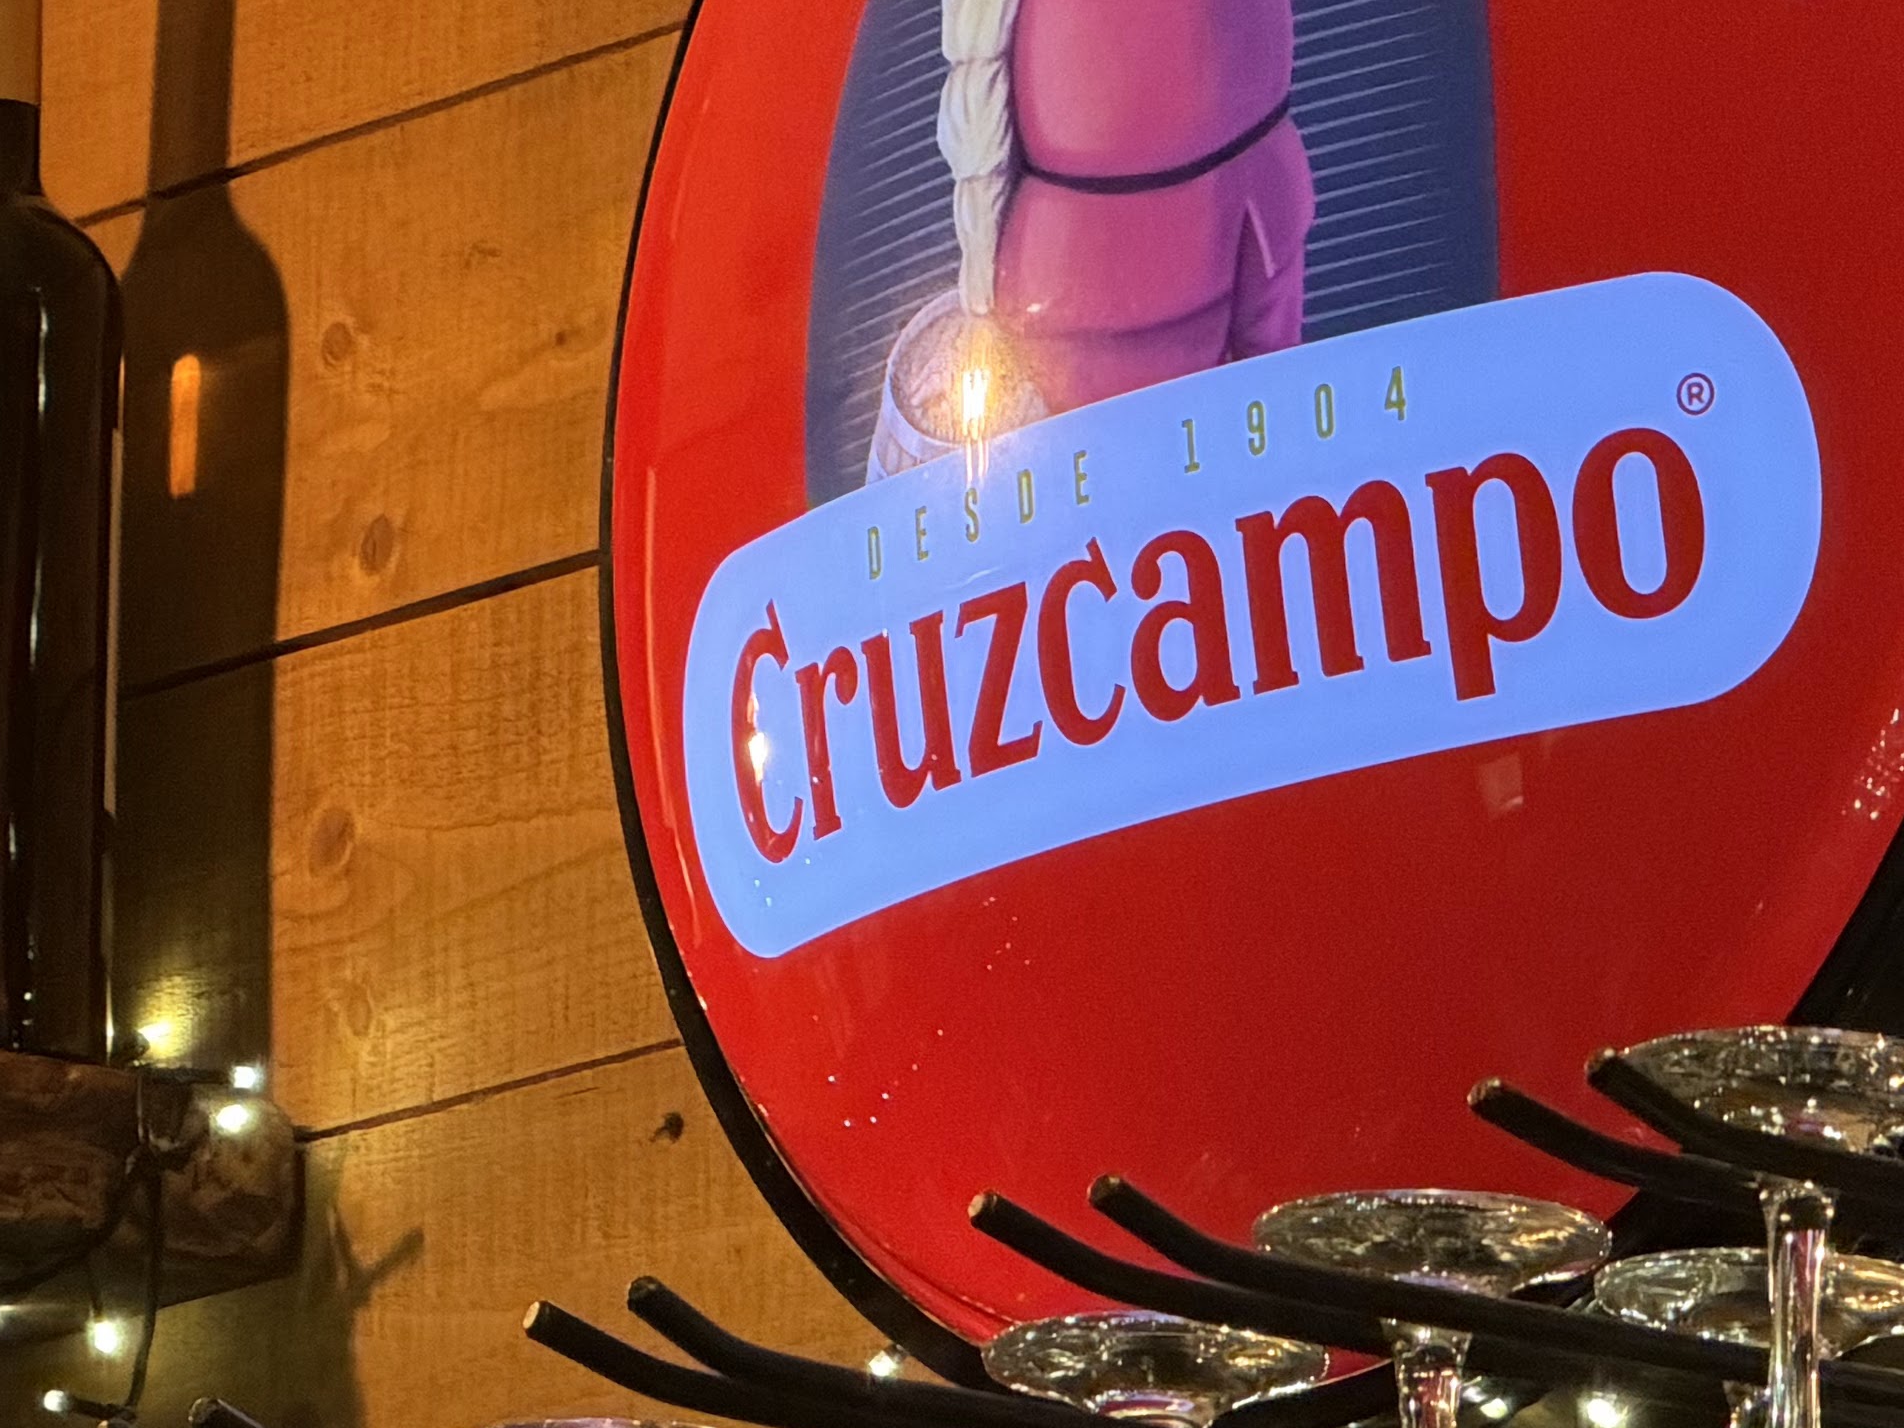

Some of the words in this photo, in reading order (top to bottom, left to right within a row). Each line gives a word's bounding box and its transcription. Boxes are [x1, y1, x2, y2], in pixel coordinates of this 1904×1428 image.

[866, 448, 1092, 581] DESDE
[1180, 365, 1410, 474] 1904
[730, 427, 1706, 865] Cruzcampo
